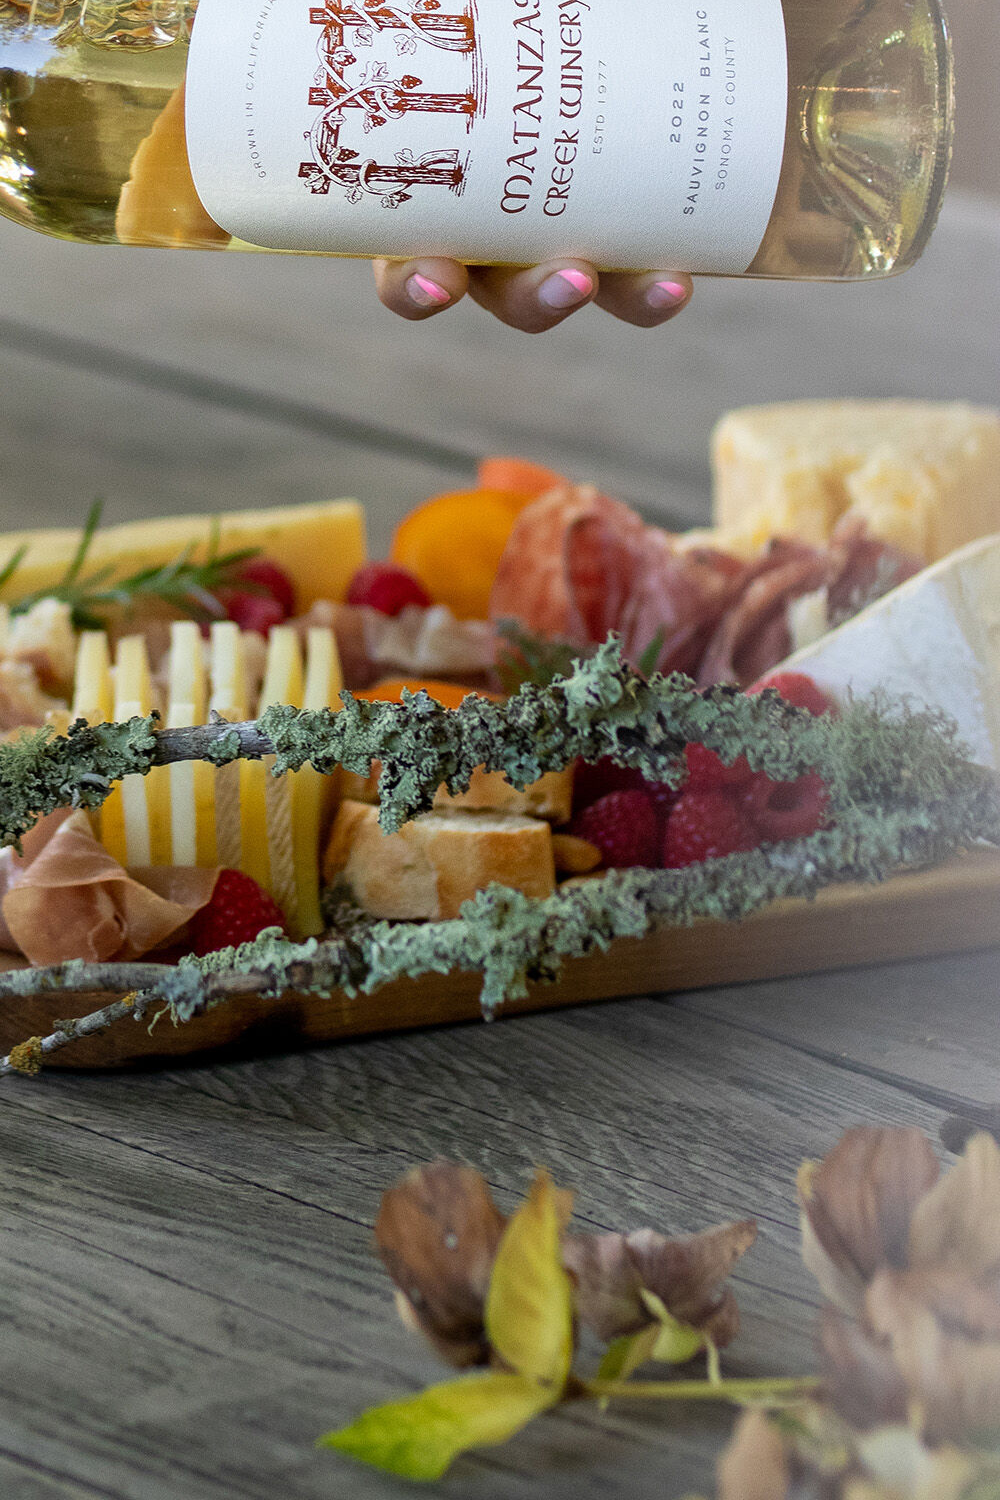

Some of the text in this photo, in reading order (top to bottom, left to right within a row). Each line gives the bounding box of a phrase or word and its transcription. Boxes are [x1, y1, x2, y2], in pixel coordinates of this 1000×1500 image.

[245, 101, 254, 118] IN
[592, 58, 608, 155] ESTD 1977
[669, 81, 685, 144] 2022
[682, 9, 711, 216] SAUVIGNON BLANC
[714, 36, 737, 191] SONOMA COUNTY
[246, 128, 267, 179] GROWN
[542, 128, 581, 217] CREEK
